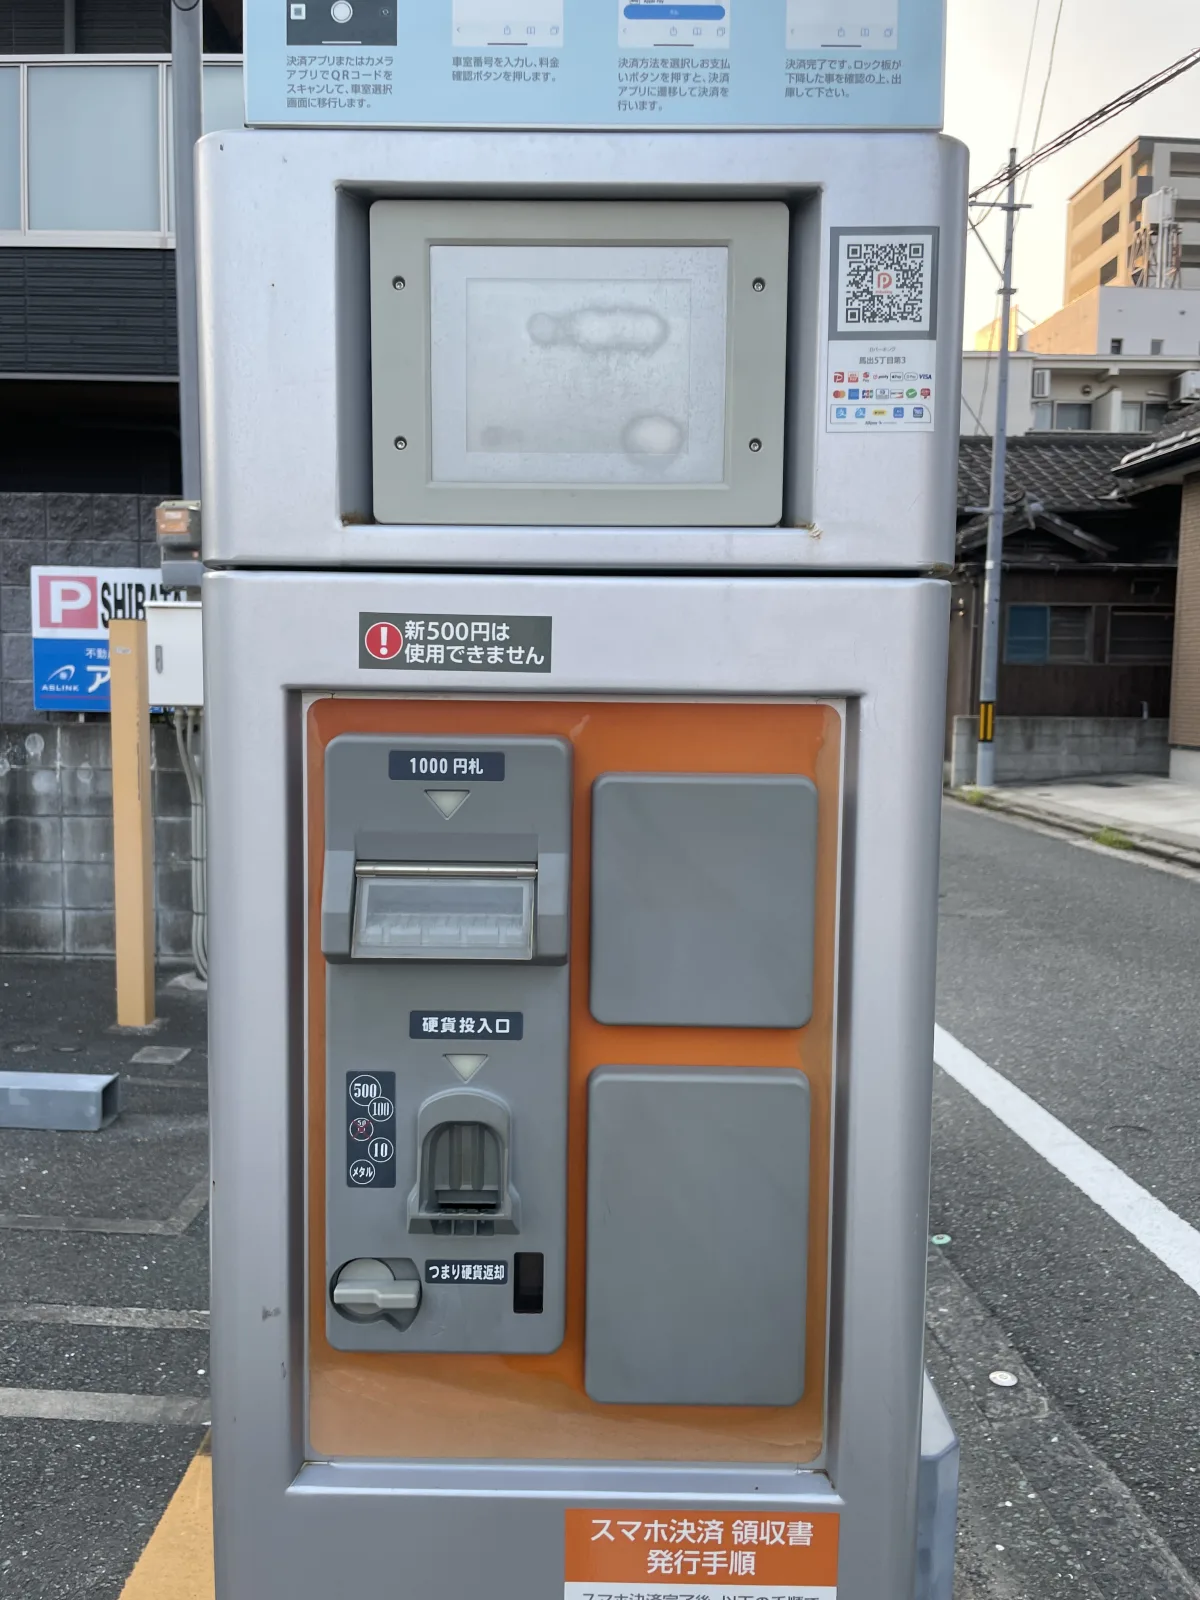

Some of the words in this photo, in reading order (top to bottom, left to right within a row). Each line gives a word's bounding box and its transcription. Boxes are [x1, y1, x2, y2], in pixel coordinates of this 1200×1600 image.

[286, 56, 394, 67] 決済アプリまたはカメラ
[452, 56, 560, 69] 車室番号を入力し、料金
[617, 58, 731, 70] 決済方法を選択しお支払
[785, 59, 902, 71] 決済完了です。ロック板が
[286, 69, 393, 81] アプリでQRコードを
[452, 70, 557, 82] 確認ボタンを押します。
[617, 72, 730, 84] いボタンを押すと、決済
[785, 73, 902, 85] 下降した事を確認の上、出
[286, 83, 393, 95] スキャンして、車室選択
[617, 86, 729, 98] アプリに遷移して決済を
[785, 87, 850, 98] 庫して下さい。
[286, 97, 372, 109] 画面に移行します。
[617, 100, 663, 112] 行います。
[50, 580, 92, 624] P
[101, 582, 181, 629] SHIB
[404, 620, 510, 642] 新500円は
[85, 648, 110, 660] 不動
[404, 643, 545, 665] 使用できません
[41, 684, 79, 692] ASLINK
[422, 1017, 510, 1034] 硬貨投入口
[353, 1083, 377, 1099] 500
[372, 1102, 390, 1116] 100
[374, 1143, 388, 1158] 10
[352, 1166, 373, 1178] メタル
[429, 1264, 505, 1281] つまり硬貨返却
[591, 1519, 724, 1544] スマホ決済
[732, 1520, 814, 1546] 領収書
[647, 1550, 756, 1576] 発行手順
